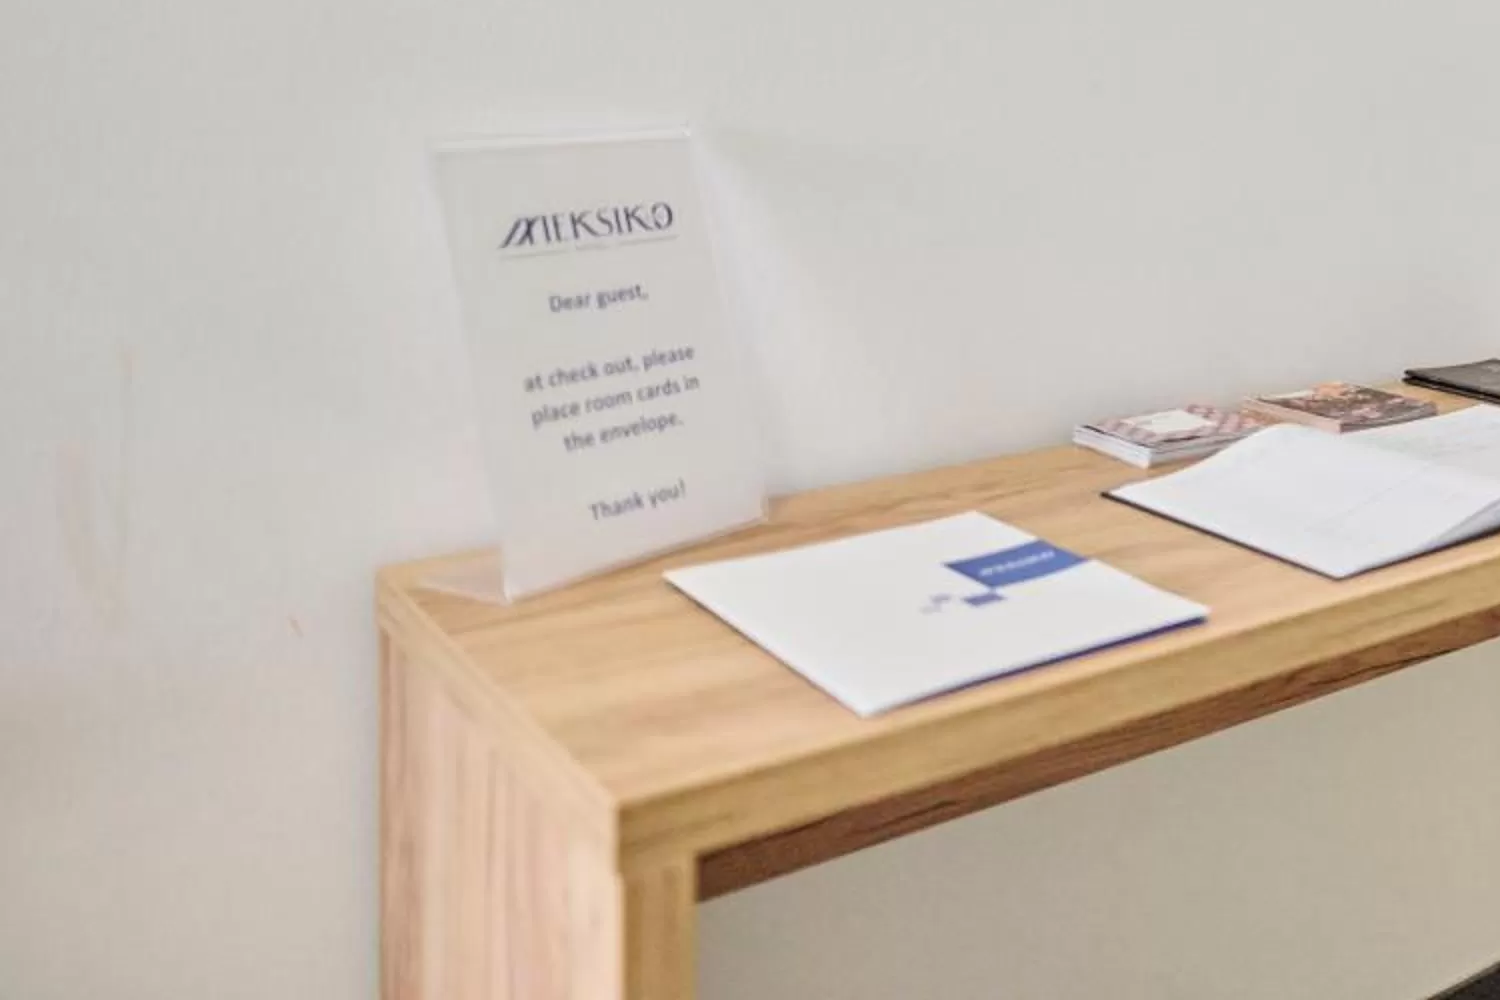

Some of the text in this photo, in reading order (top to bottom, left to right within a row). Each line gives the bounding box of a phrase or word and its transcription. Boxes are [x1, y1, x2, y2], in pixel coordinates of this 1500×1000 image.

[498, 201, 674, 250] MEKSIKO
[549, 283, 649, 314] Dear guest,
[524, 344, 695, 393] at check out, please
[531, 374, 700, 430] place room cards in
[563, 411, 684, 453] the envelope.
[590, 478, 687, 521] Thank you!
